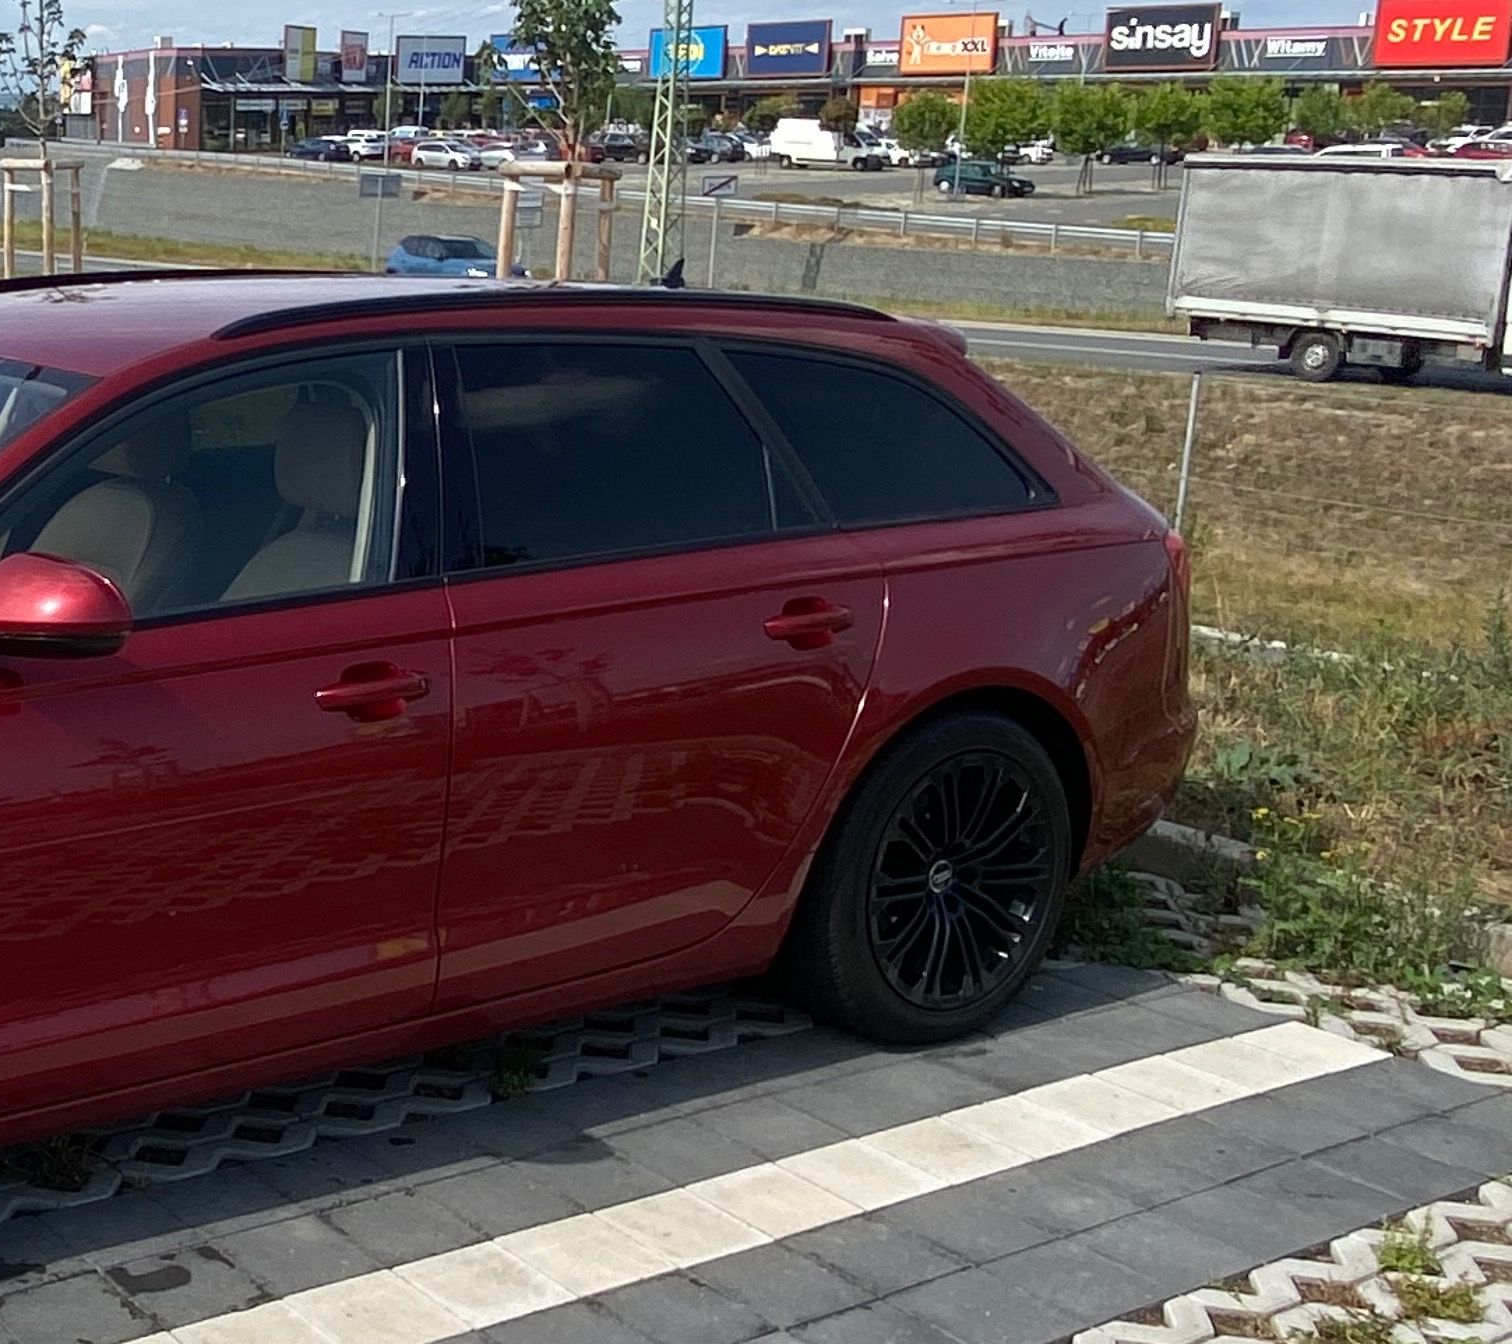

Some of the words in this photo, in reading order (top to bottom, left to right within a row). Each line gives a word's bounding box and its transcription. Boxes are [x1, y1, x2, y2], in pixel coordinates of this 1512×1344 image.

[1111, 17, 1212, 58] sinsay
[1387, 16, 1497, 43] STYLE
[407, 51, 463, 70] ACTION
